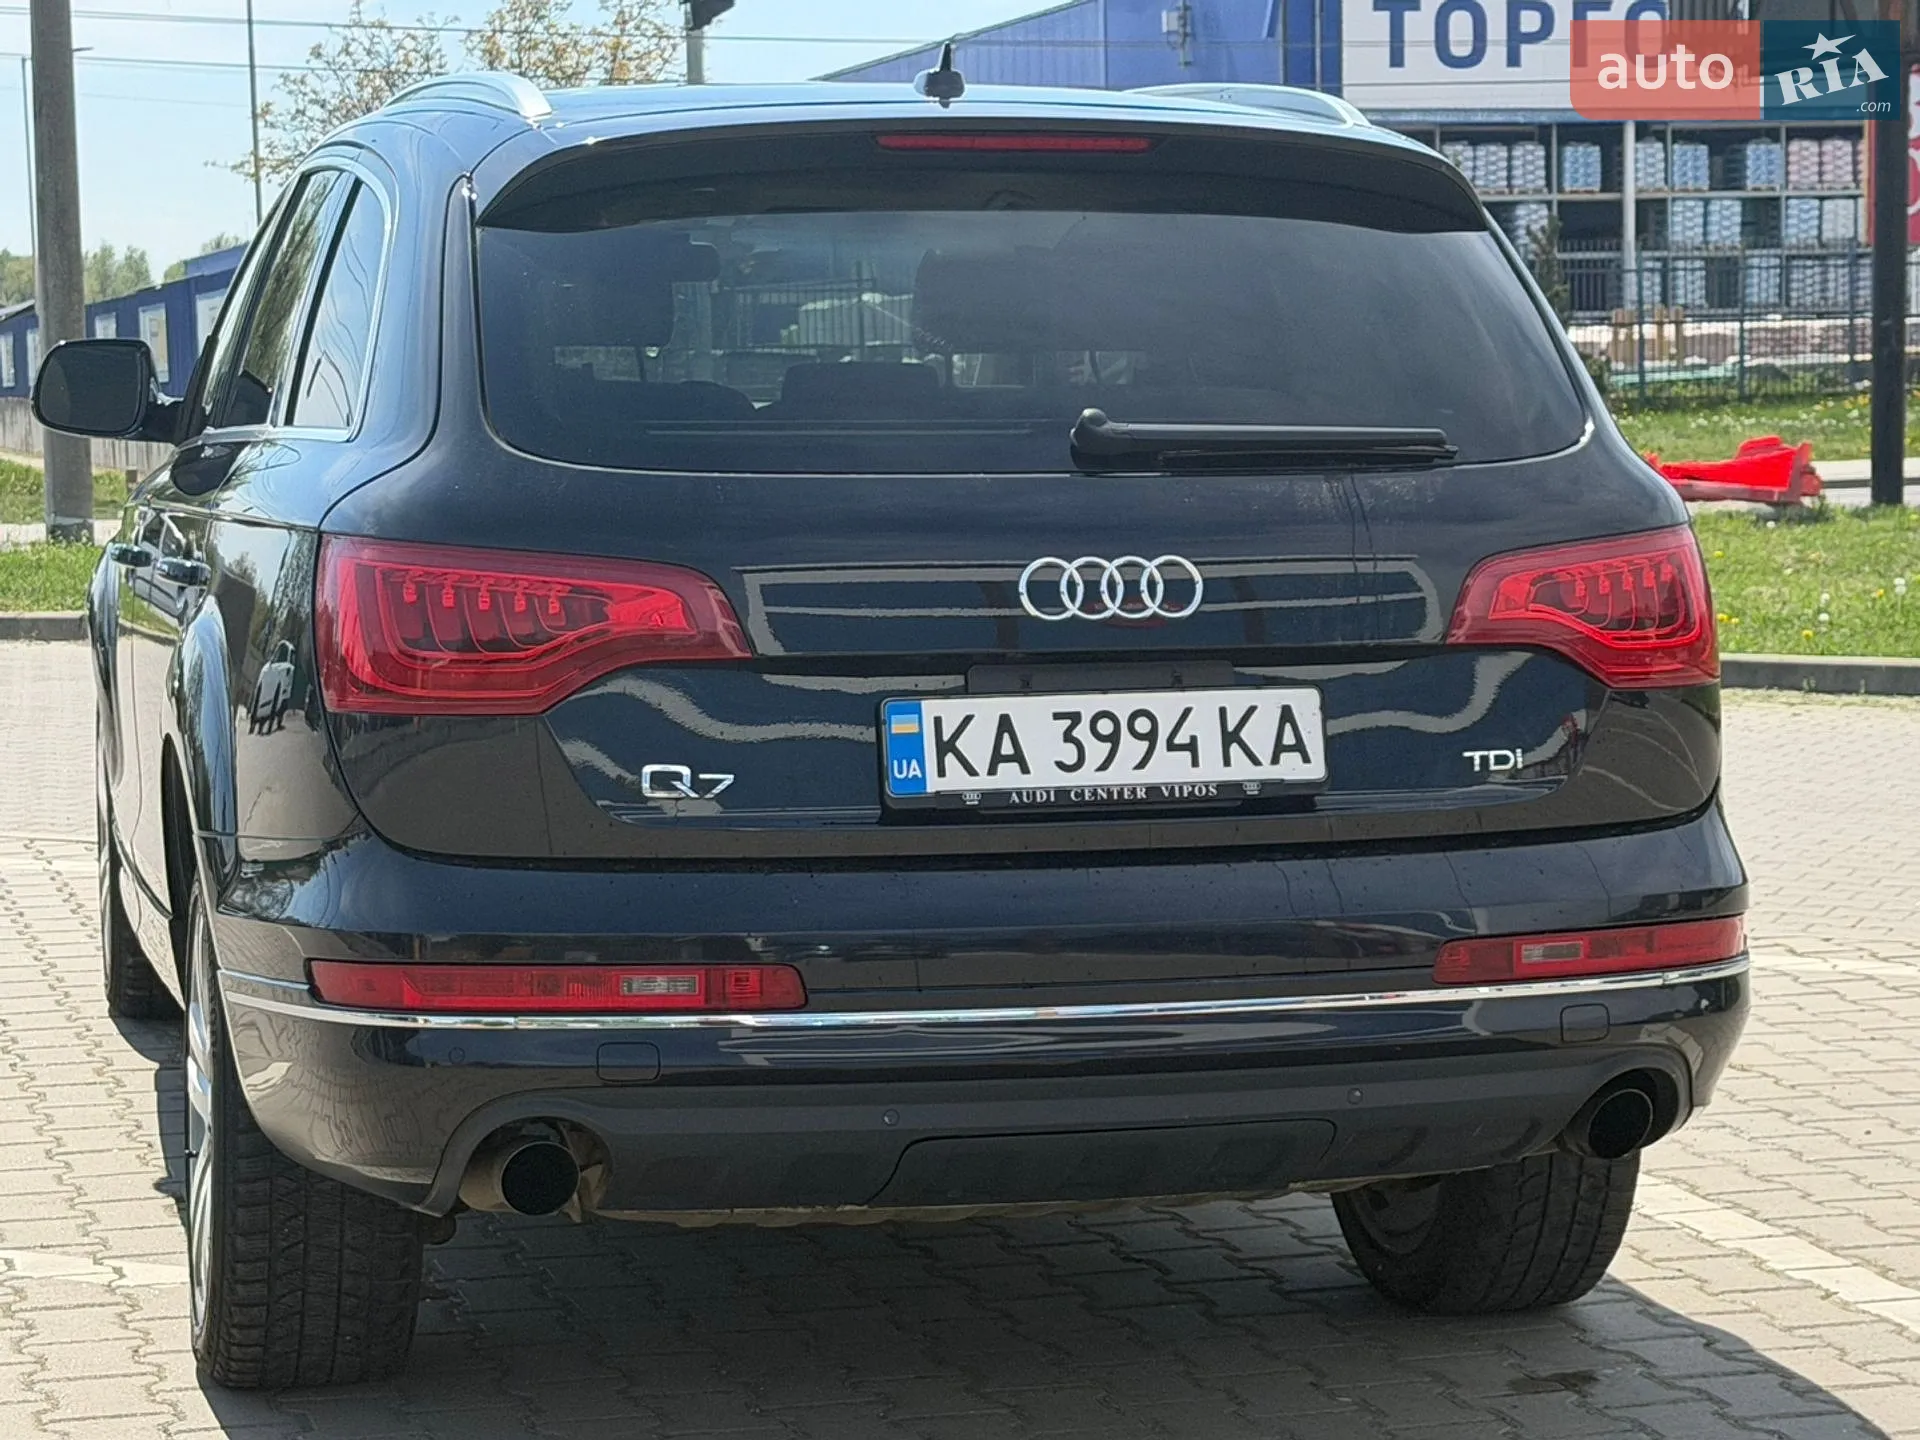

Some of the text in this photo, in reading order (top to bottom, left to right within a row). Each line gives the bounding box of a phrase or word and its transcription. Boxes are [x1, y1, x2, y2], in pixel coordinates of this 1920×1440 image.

[933, 704, 1312, 778] KA 3994 KA
[642, 764, 735, 798] Q7
[893, 760, 922, 779] UA
[1009, 783, 1219, 804] AUDI CENTER VIPOS
